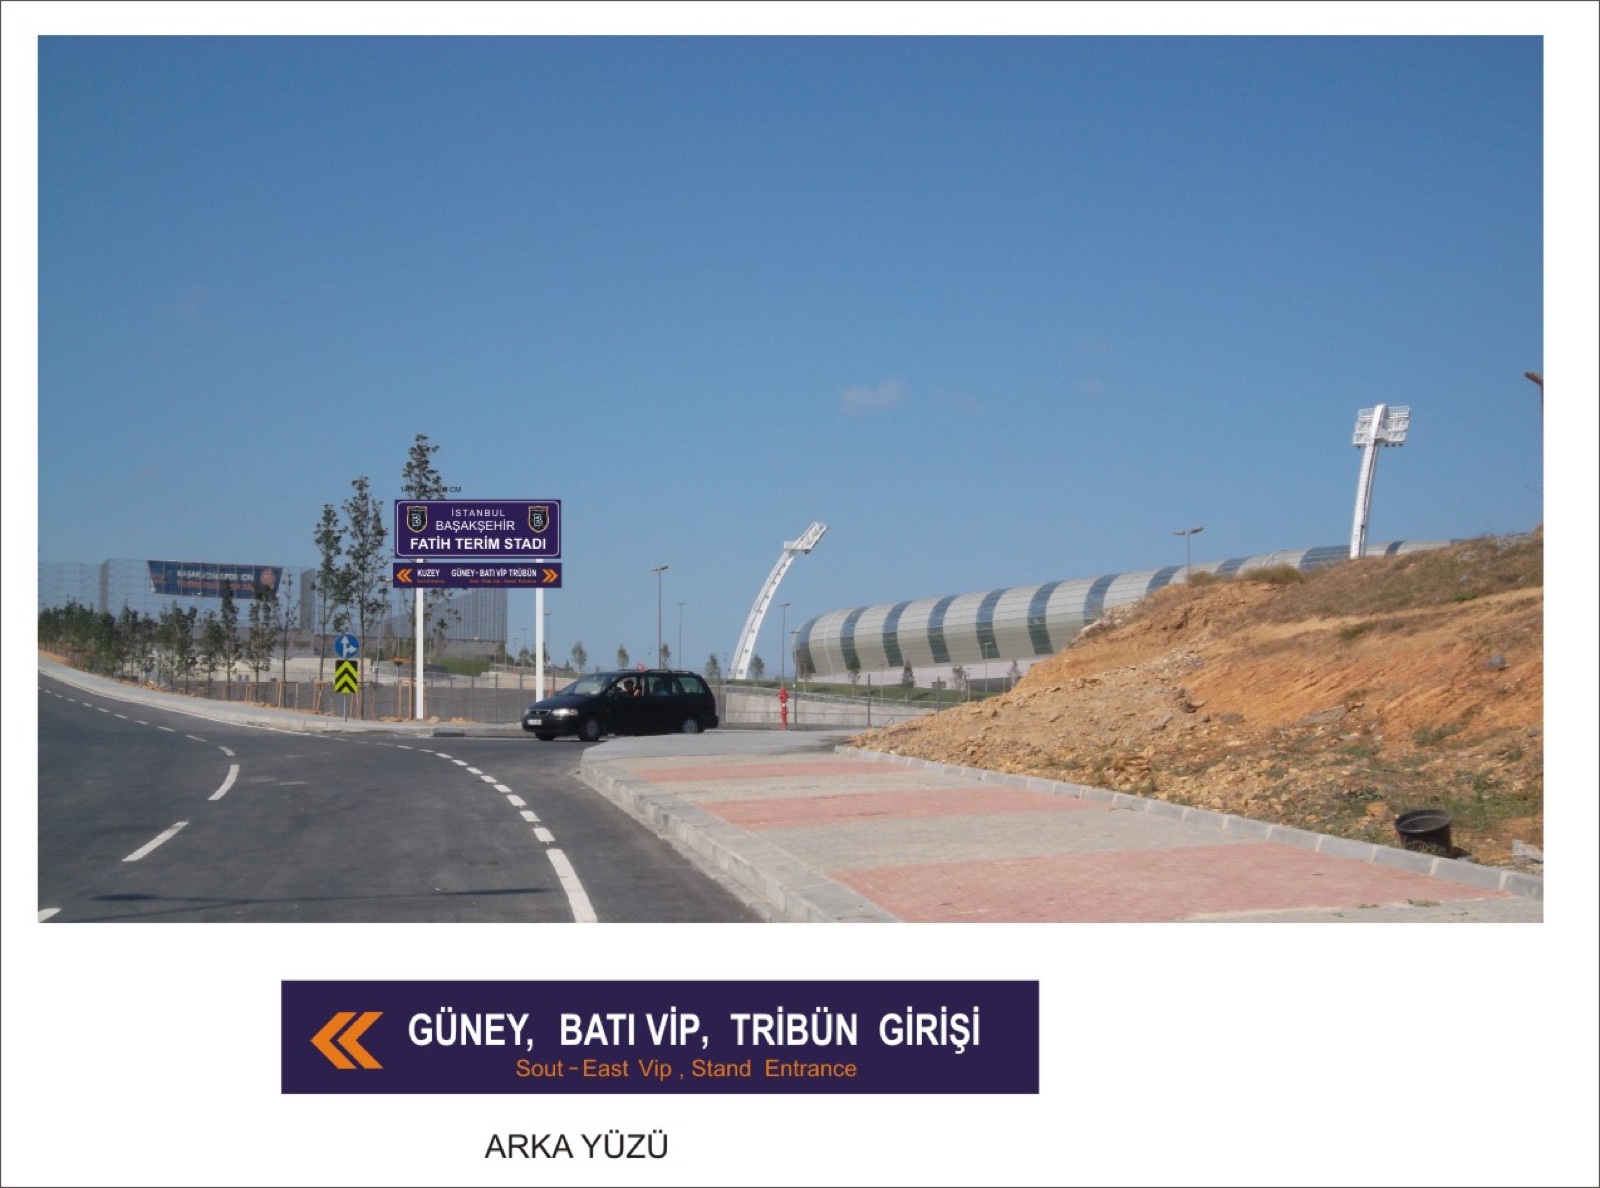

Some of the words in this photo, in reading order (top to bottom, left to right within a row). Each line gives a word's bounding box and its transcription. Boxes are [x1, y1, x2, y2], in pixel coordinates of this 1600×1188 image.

[451, 507, 506, 517] İSTANBUL
[435, 518, 516, 533] BAŞAKŞEHİR
[410, 535, 451, 550] FATİH
[455, 535, 500, 550] TERİM
[504, 537, 546, 550] STADI
[417, 568, 440, 577] KUZEY
[408, 1006, 534, 1052] GÜNEY,
[560, 1013, 635, 1046] BATI
[646, 1005, 709, 1051] VİP,
[730, 1005, 858, 1046] TRİBÜN
[879, 1005, 980, 1055] GİRİŞİ
[692, 1059, 751, 1077] Stand
[765, 1059, 857, 1077] Entrance
